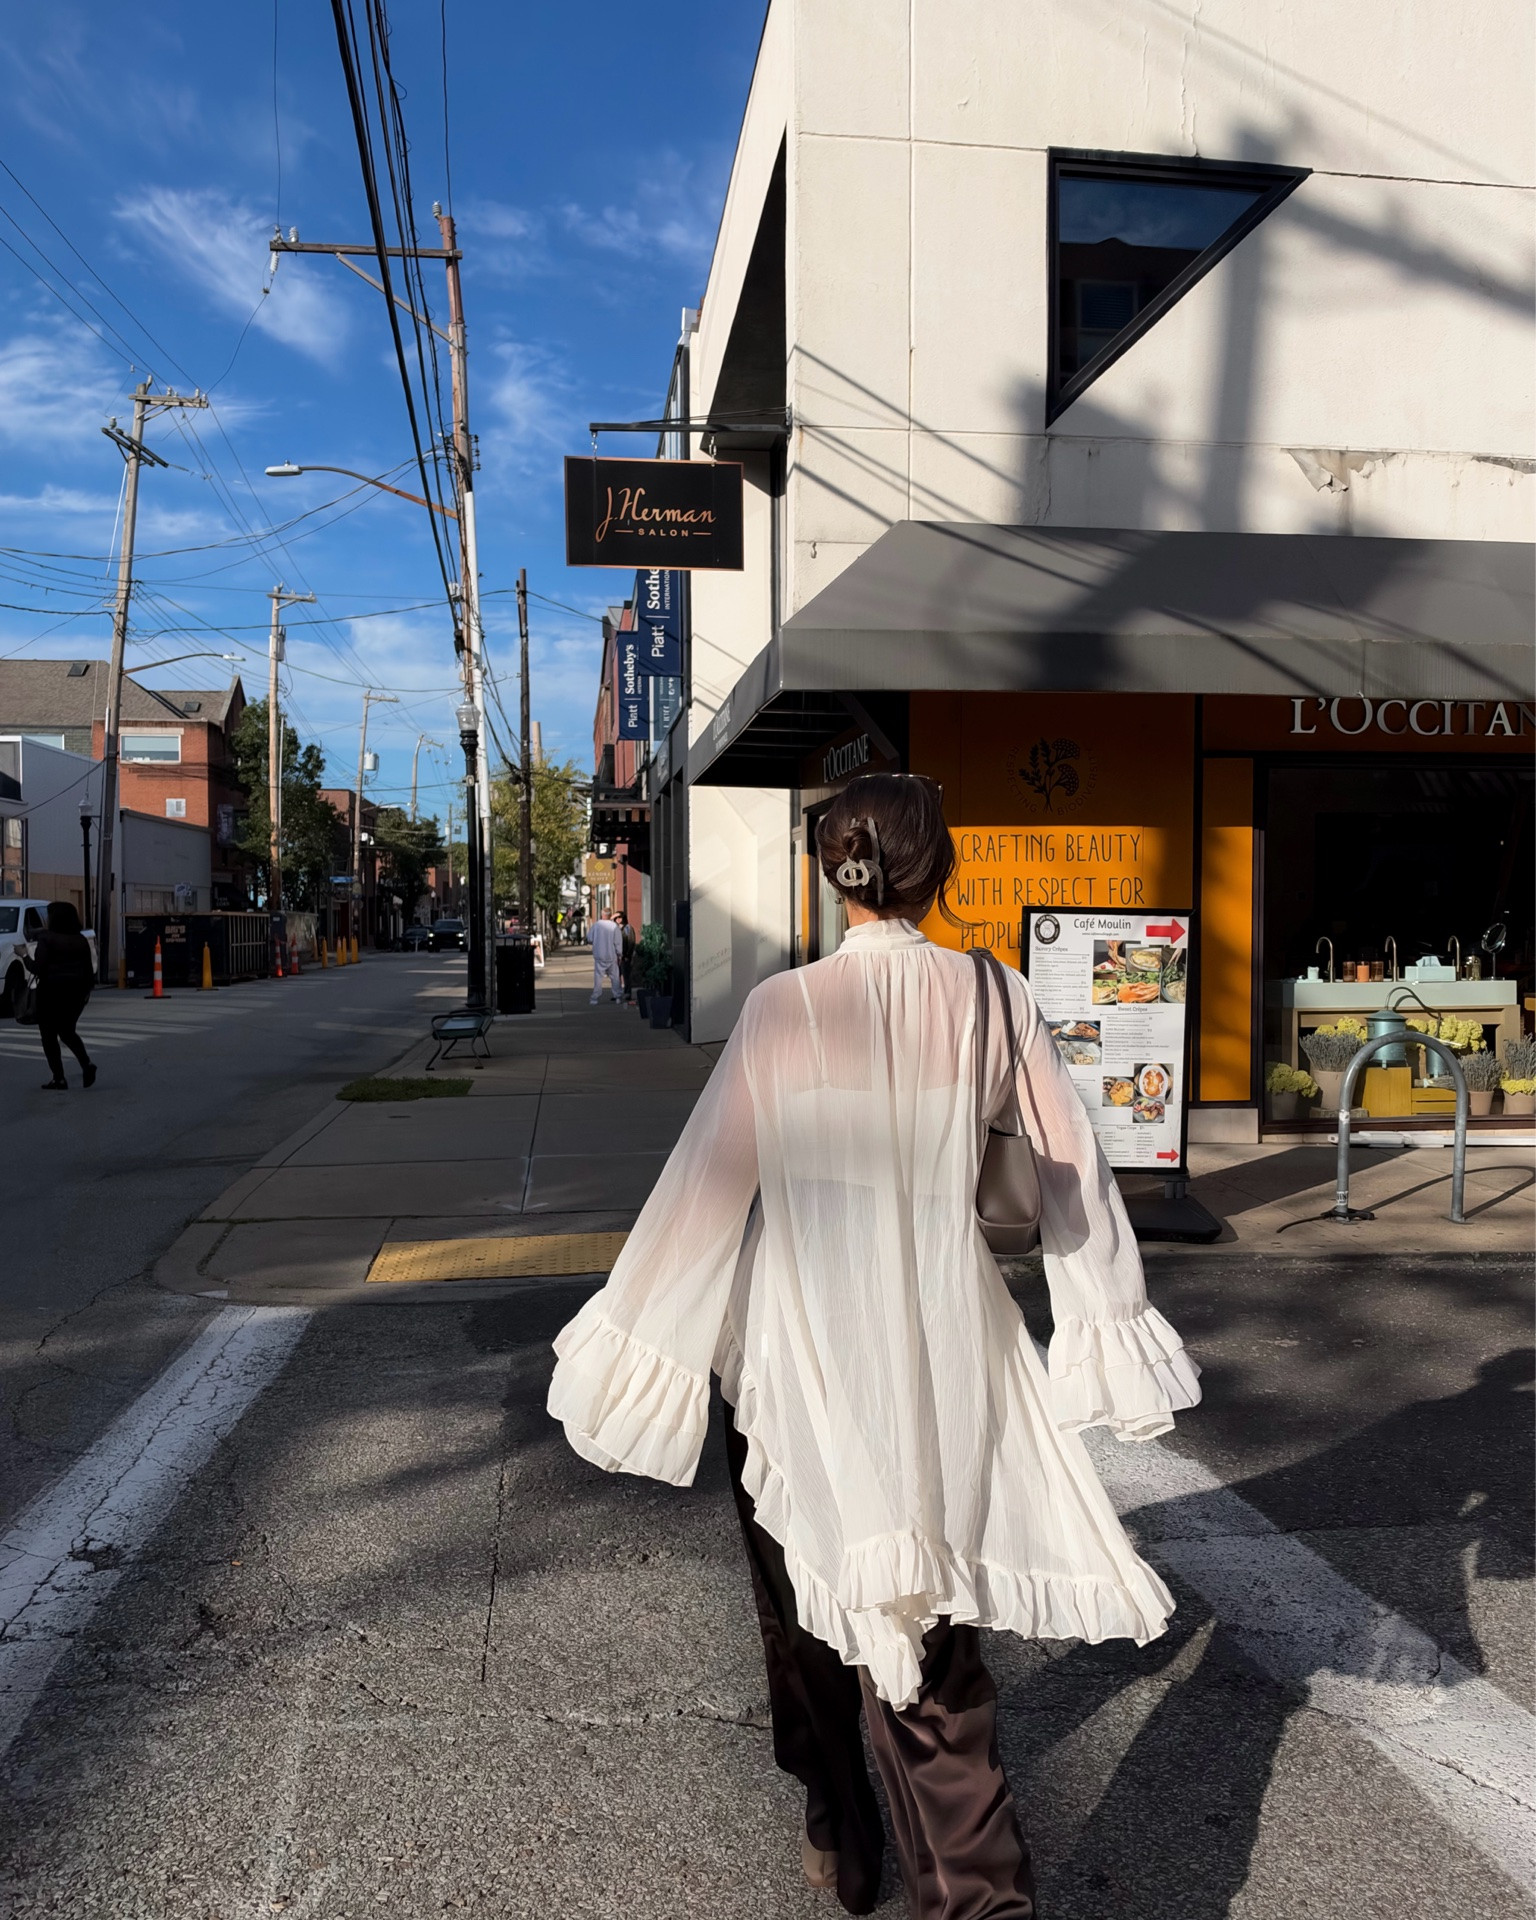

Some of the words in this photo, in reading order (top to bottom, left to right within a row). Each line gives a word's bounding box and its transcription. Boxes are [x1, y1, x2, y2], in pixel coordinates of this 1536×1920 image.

[638, 527, 689, 538] SALON
[651, 625, 665, 658] Piatt
[623, 644, 636, 695] Sotheby's
[628, 704, 639, 728] Piatt
[822, 732, 870, 784] L'OCCITANE
[960, 833, 1055, 863] CRAFTING
[1065, 833, 1141, 863] BEAUTY
[957, 878, 1002, 906] WITH
[1013, 876, 1097, 907] RESPECT
[1108, 877, 1145, 905] FOR
[961, 921, 1022, 949] PEOPLE
[1073, 917, 1095, 931] Café
[1097, 918, 1132, 930] Moulin
